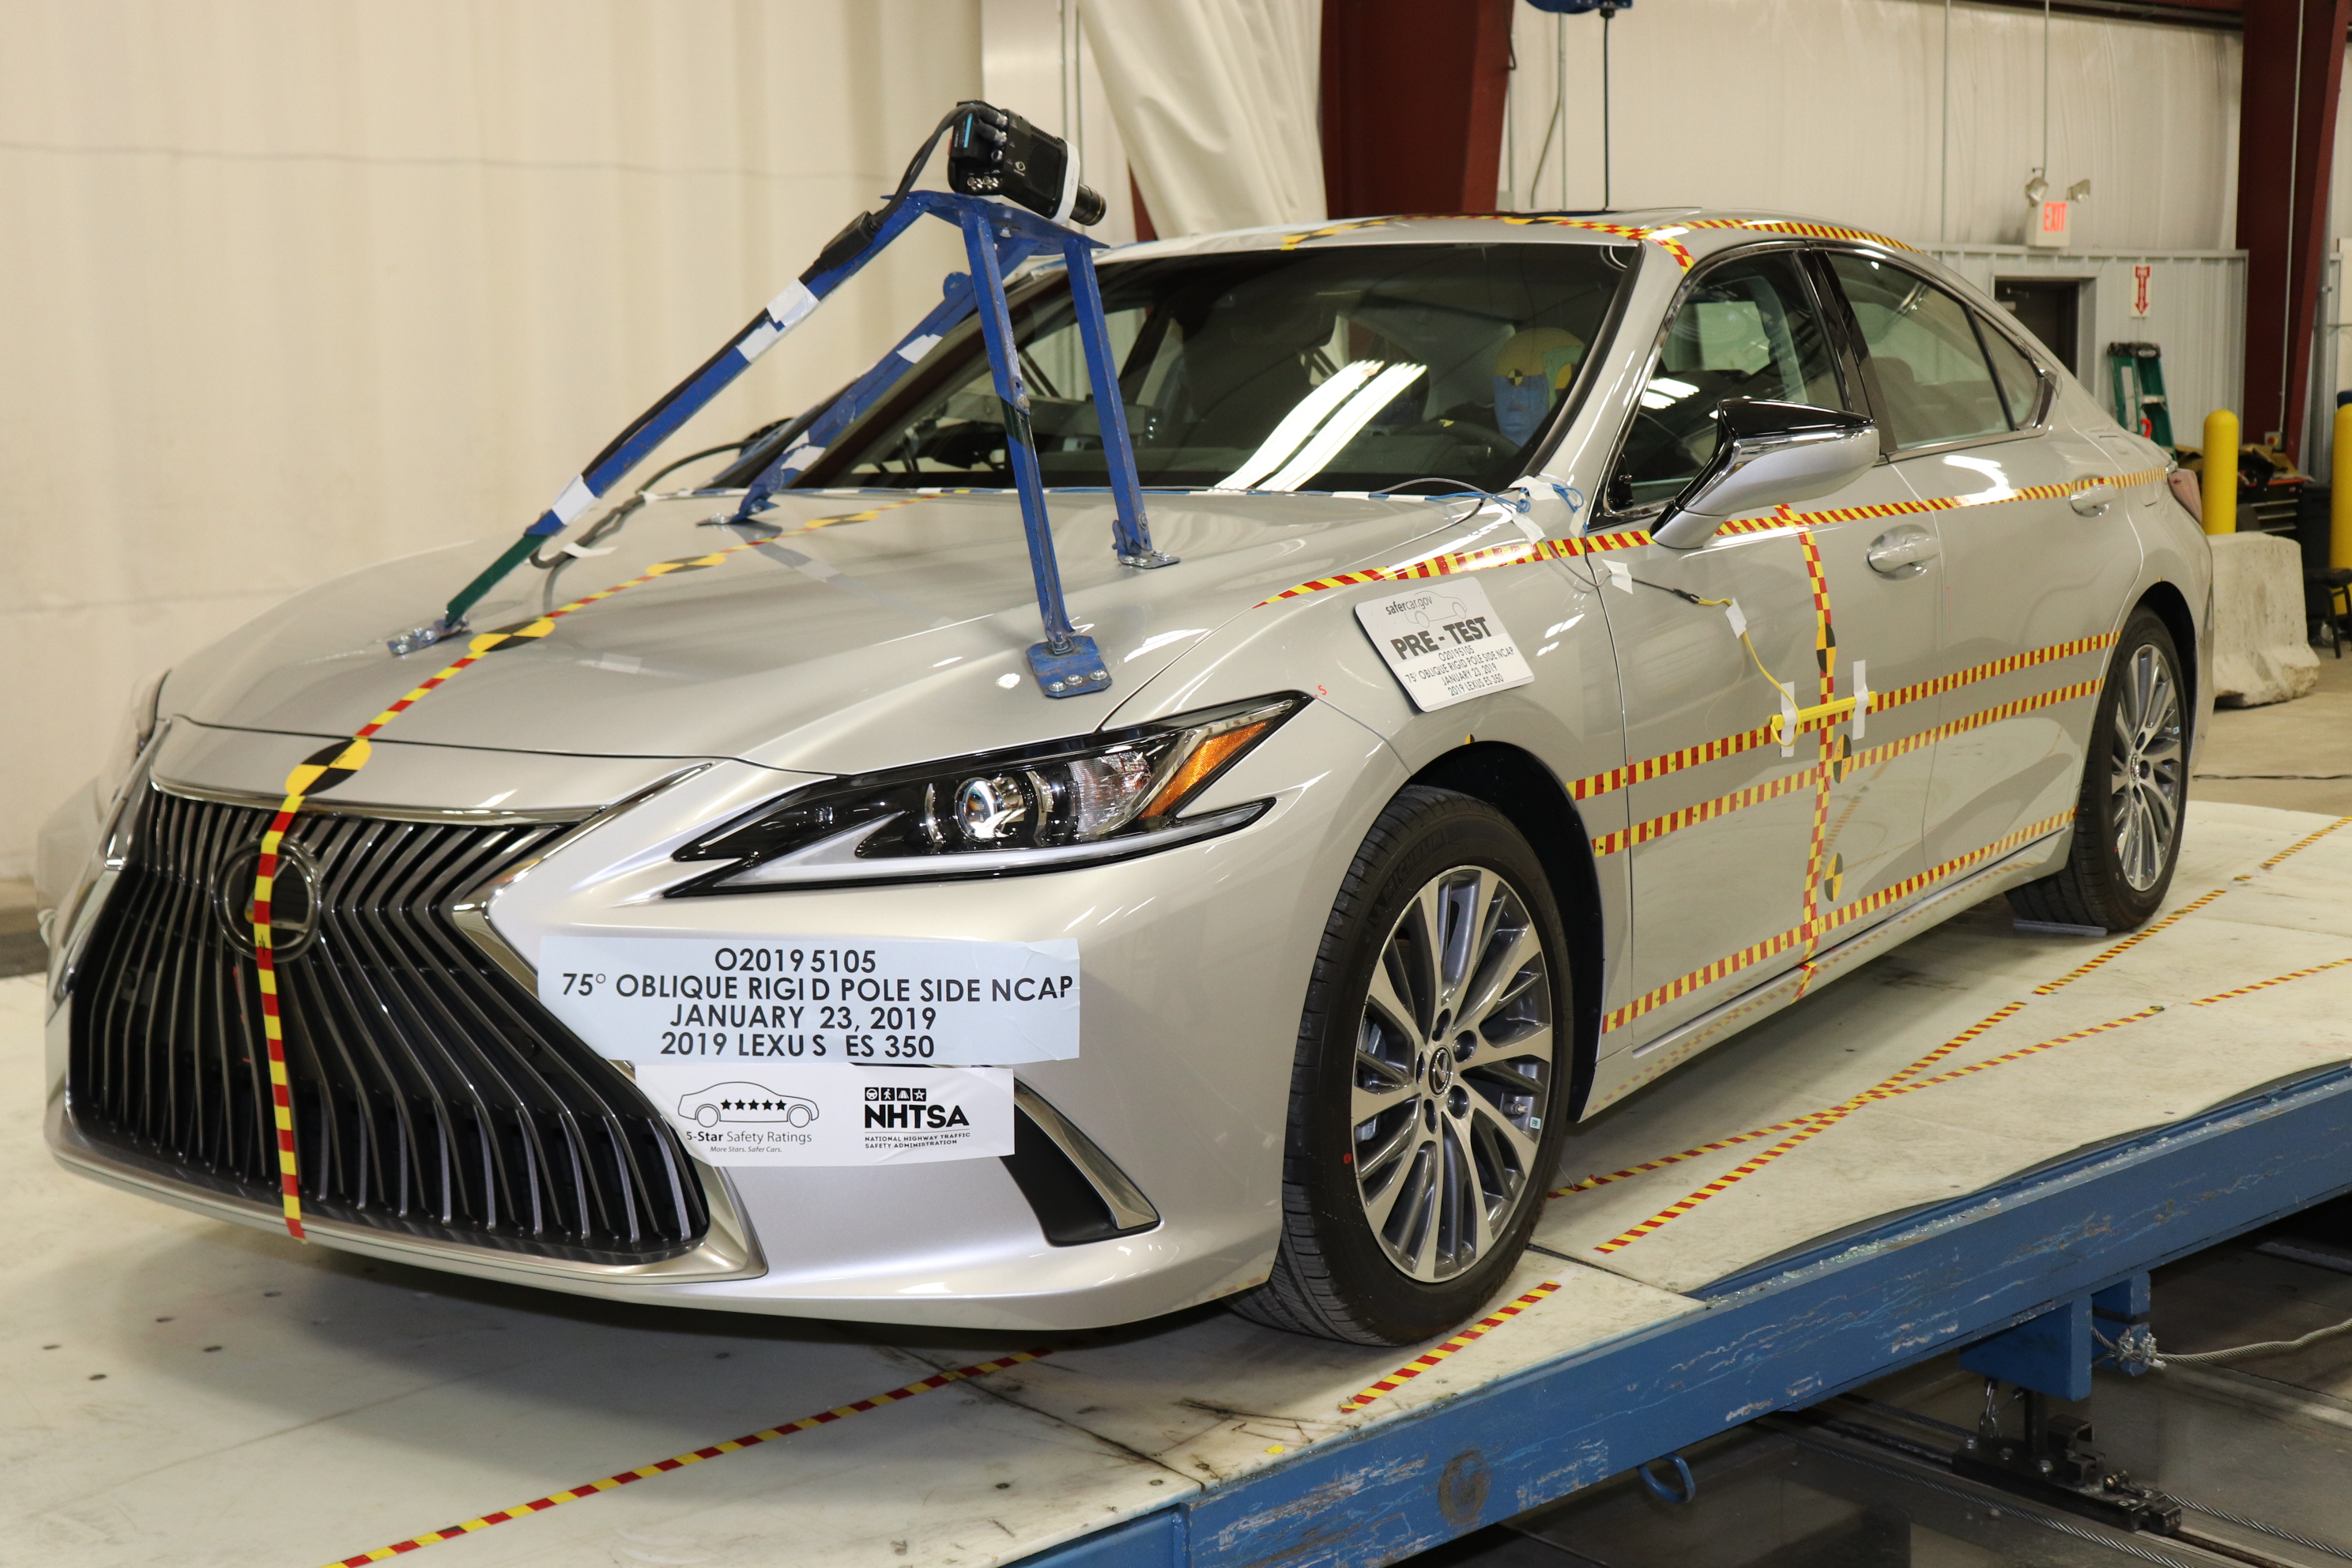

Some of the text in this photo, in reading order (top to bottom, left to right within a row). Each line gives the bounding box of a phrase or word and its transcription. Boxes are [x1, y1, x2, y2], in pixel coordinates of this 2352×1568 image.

[2044, 202, 2067, 231] EXIT
[1385, 595, 1432, 615] safercar.gov
[1418, 664, 1449, 680] OBLIQUE
[1448, 658, 1468, 671] RIGID
[1466, 654, 1484, 665] POLE
[1482, 651, 1498, 662] SIDE
[1496, 646, 1515, 660] NCAP
[1441, 663, 1498, 685] JANUARY 23, 2019
[1448, 673, 1504, 695] 2019 LEXUS ES 350
[616, 974, 737, 1000] OBLIQUE
[749, 977, 830, 1001] RIGID
[841, 978, 910, 1001] POLE
[920, 978, 980, 1002] SIDE
[992, 975, 1072, 1001] NCAP
[669, 1004, 937, 1032] JANUARY 23, 2019
[660, 1031, 935, 1057] 2019 LEXUS ES 350
[865, 1104, 970, 1129] NHTSA
[686, 1131, 812, 1145] 5-Star Safety Ratings
[894, 1140, 957, 1148] ADMINISTRATION
